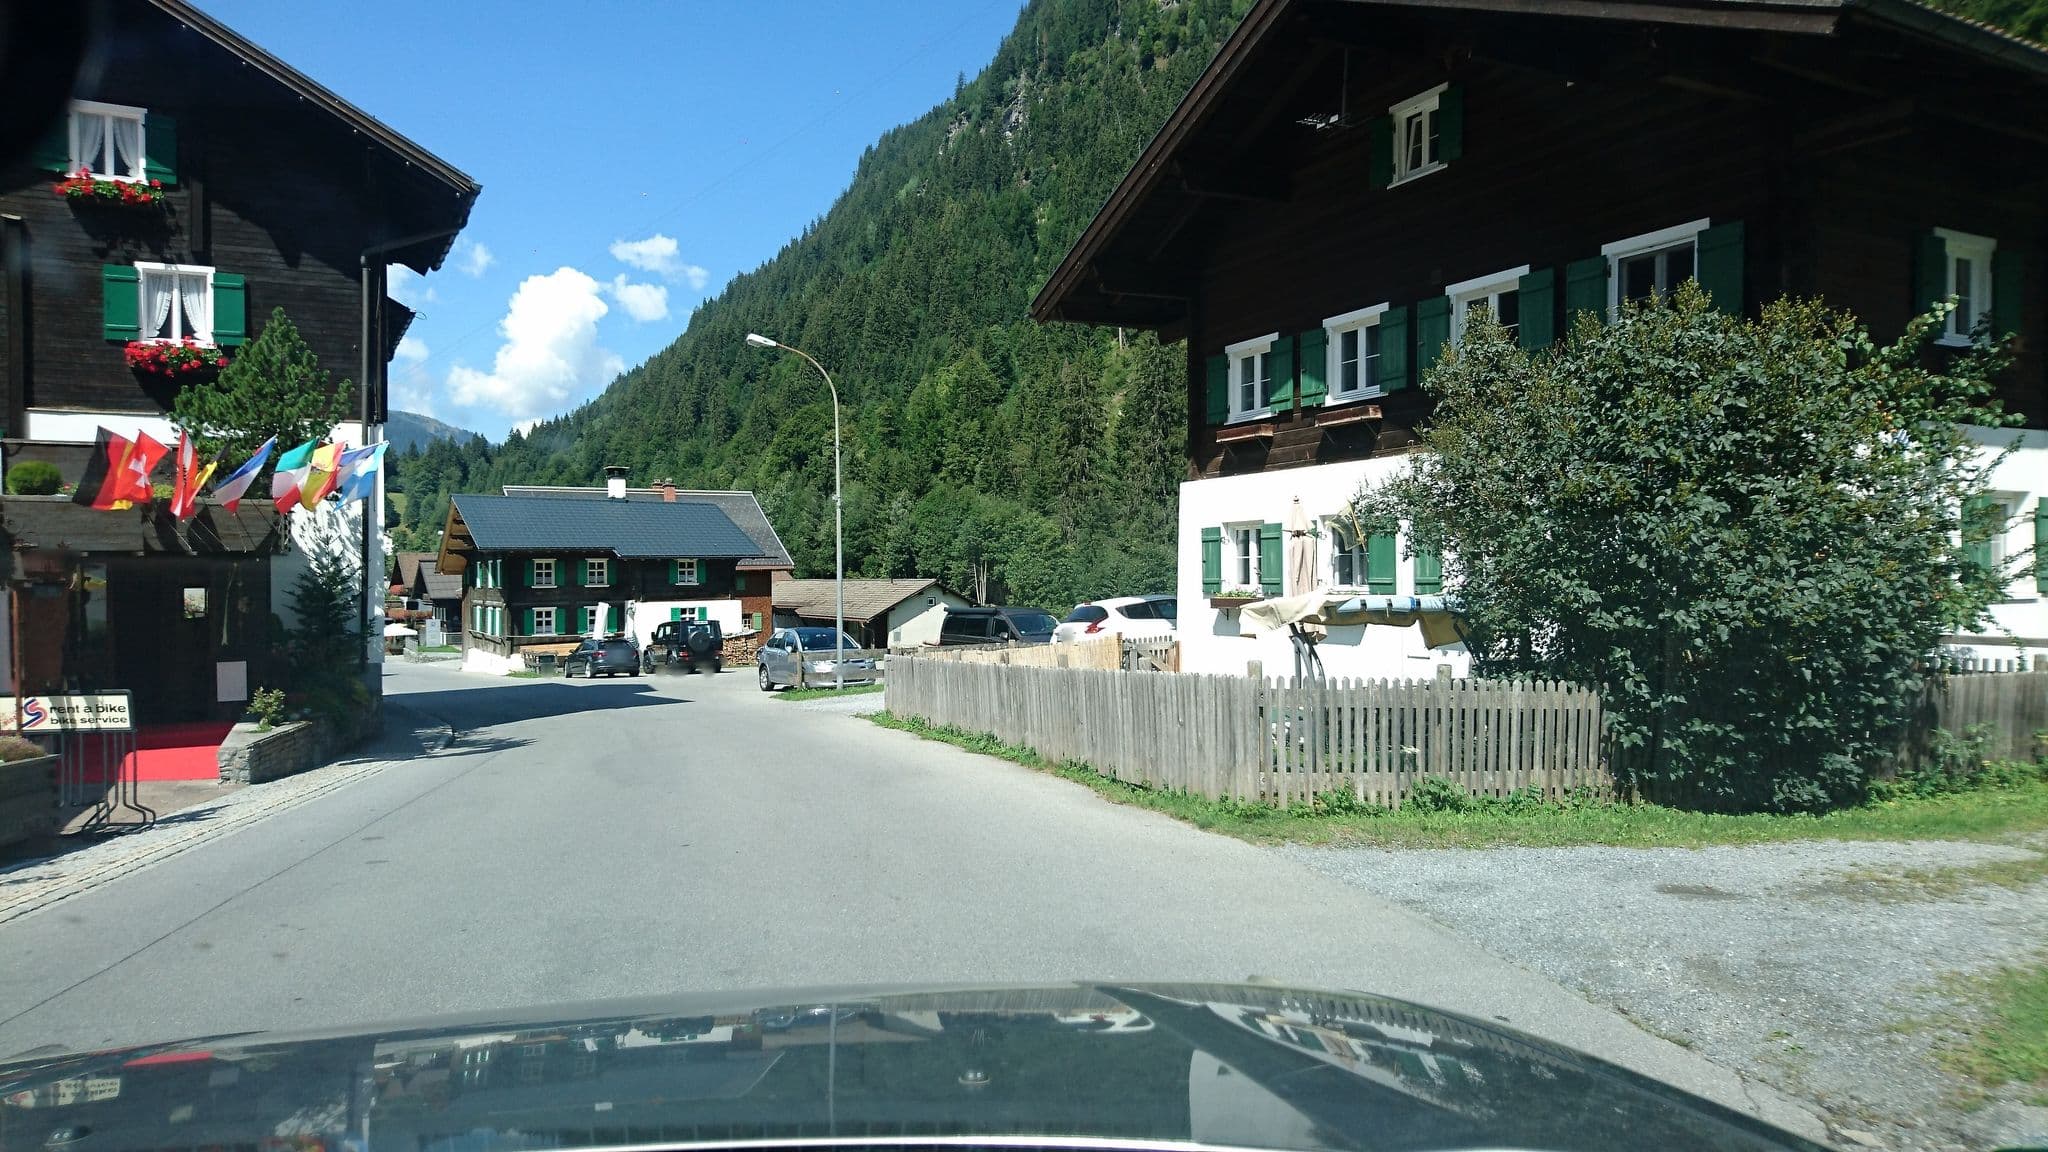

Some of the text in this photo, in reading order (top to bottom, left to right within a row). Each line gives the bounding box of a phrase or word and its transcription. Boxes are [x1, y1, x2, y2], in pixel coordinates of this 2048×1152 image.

[50, 703, 126, 714] rent a bike
[50, 716, 128, 725] bike service
